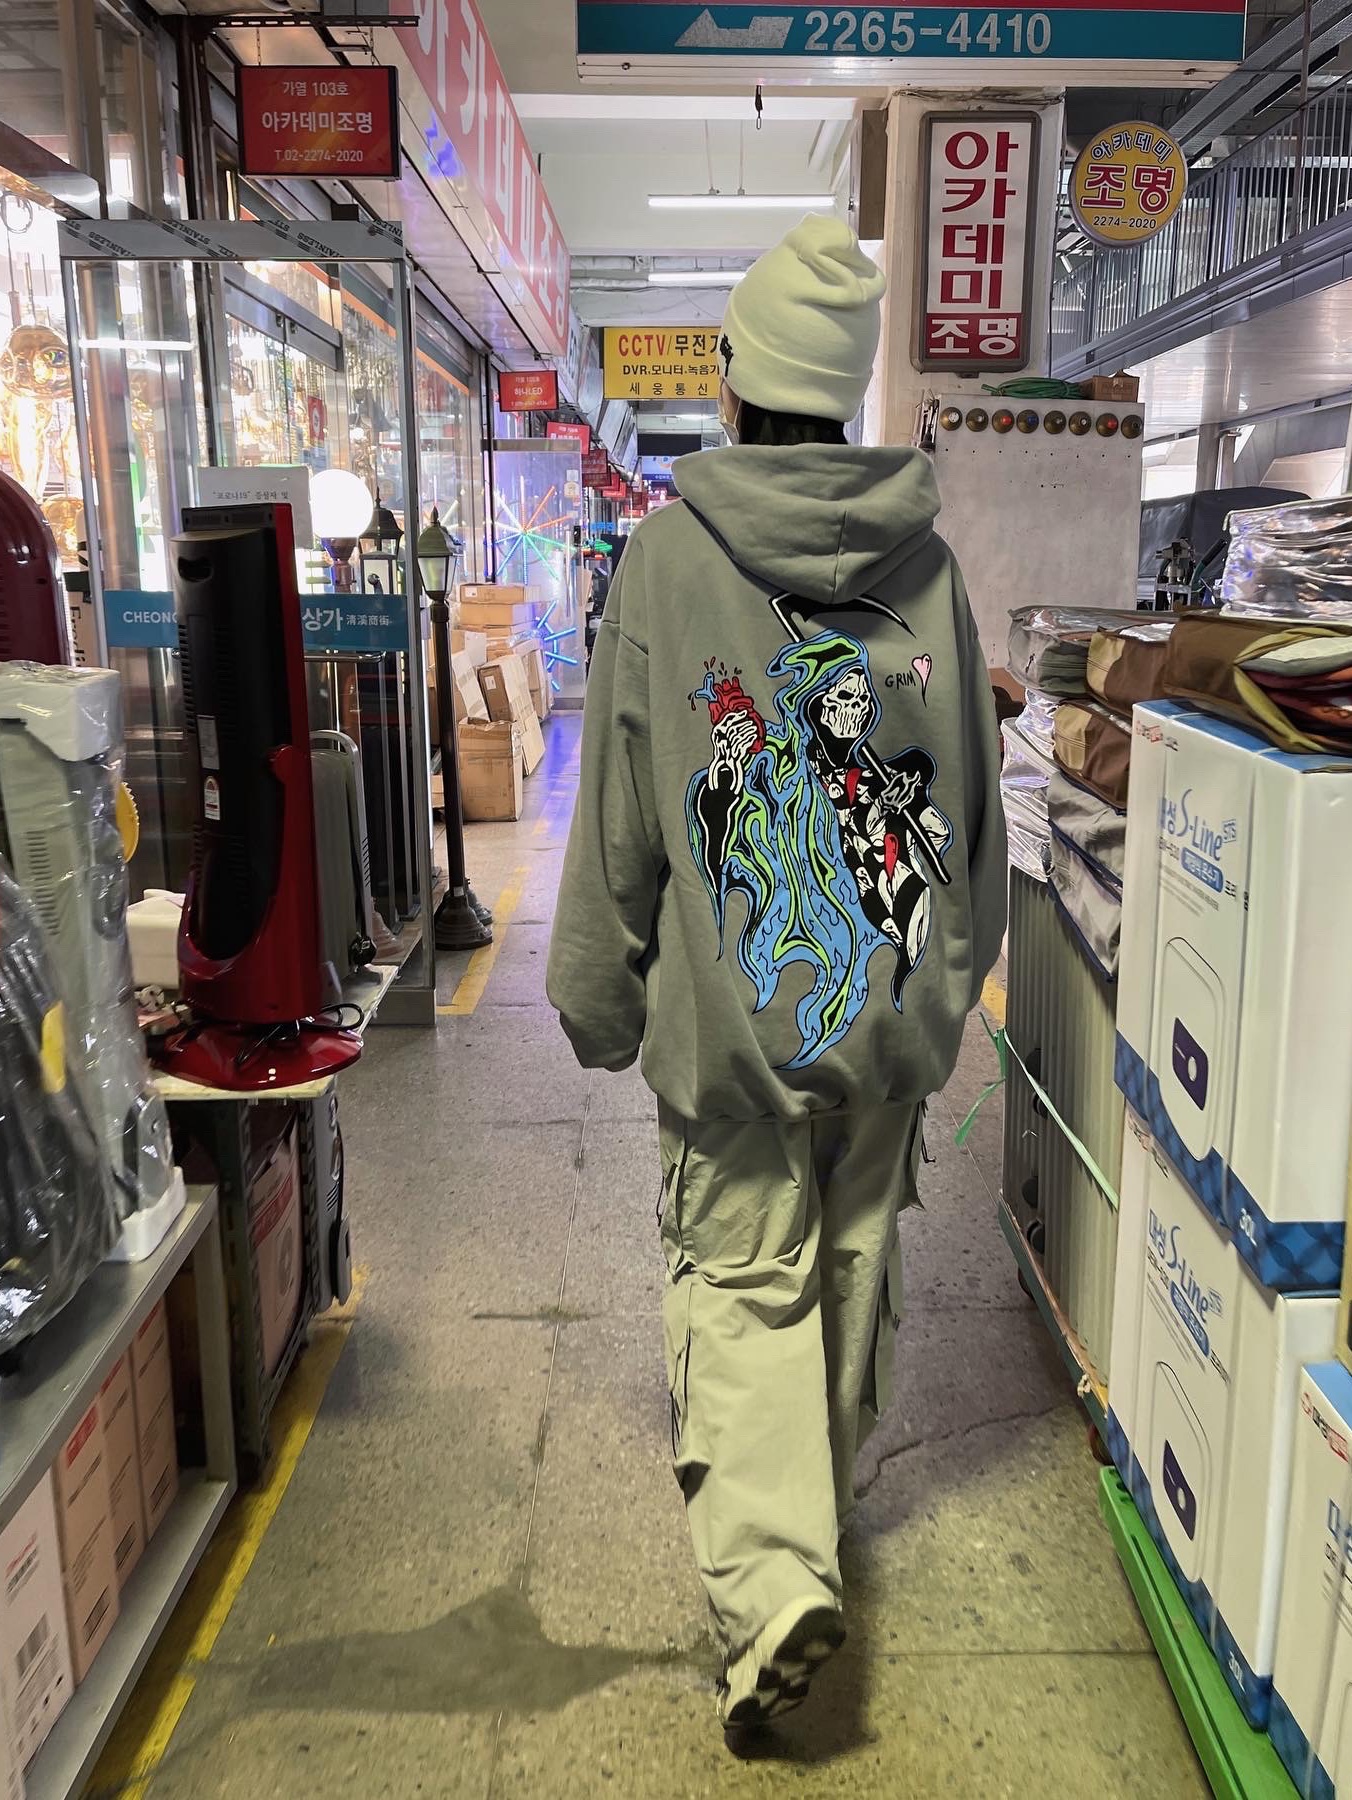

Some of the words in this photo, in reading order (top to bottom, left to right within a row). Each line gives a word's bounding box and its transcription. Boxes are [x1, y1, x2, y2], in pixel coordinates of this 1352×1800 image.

[803, 10, 1052, 55] 2265-4410
[283, 81, 307, 96] 가열
[312, 81, 349, 96] 103호
[262, 111, 373, 134] 아카데미조명
[1091, 130, 1174, 164] 아카데미
[1081, 163, 1175, 215] 조명
[1093, 215, 1157, 229] 2274-2020
[929, 317, 1018, 356] 조명
[302, 607, 343, 631] 상가
[885, 670, 917, 691] GRIM
